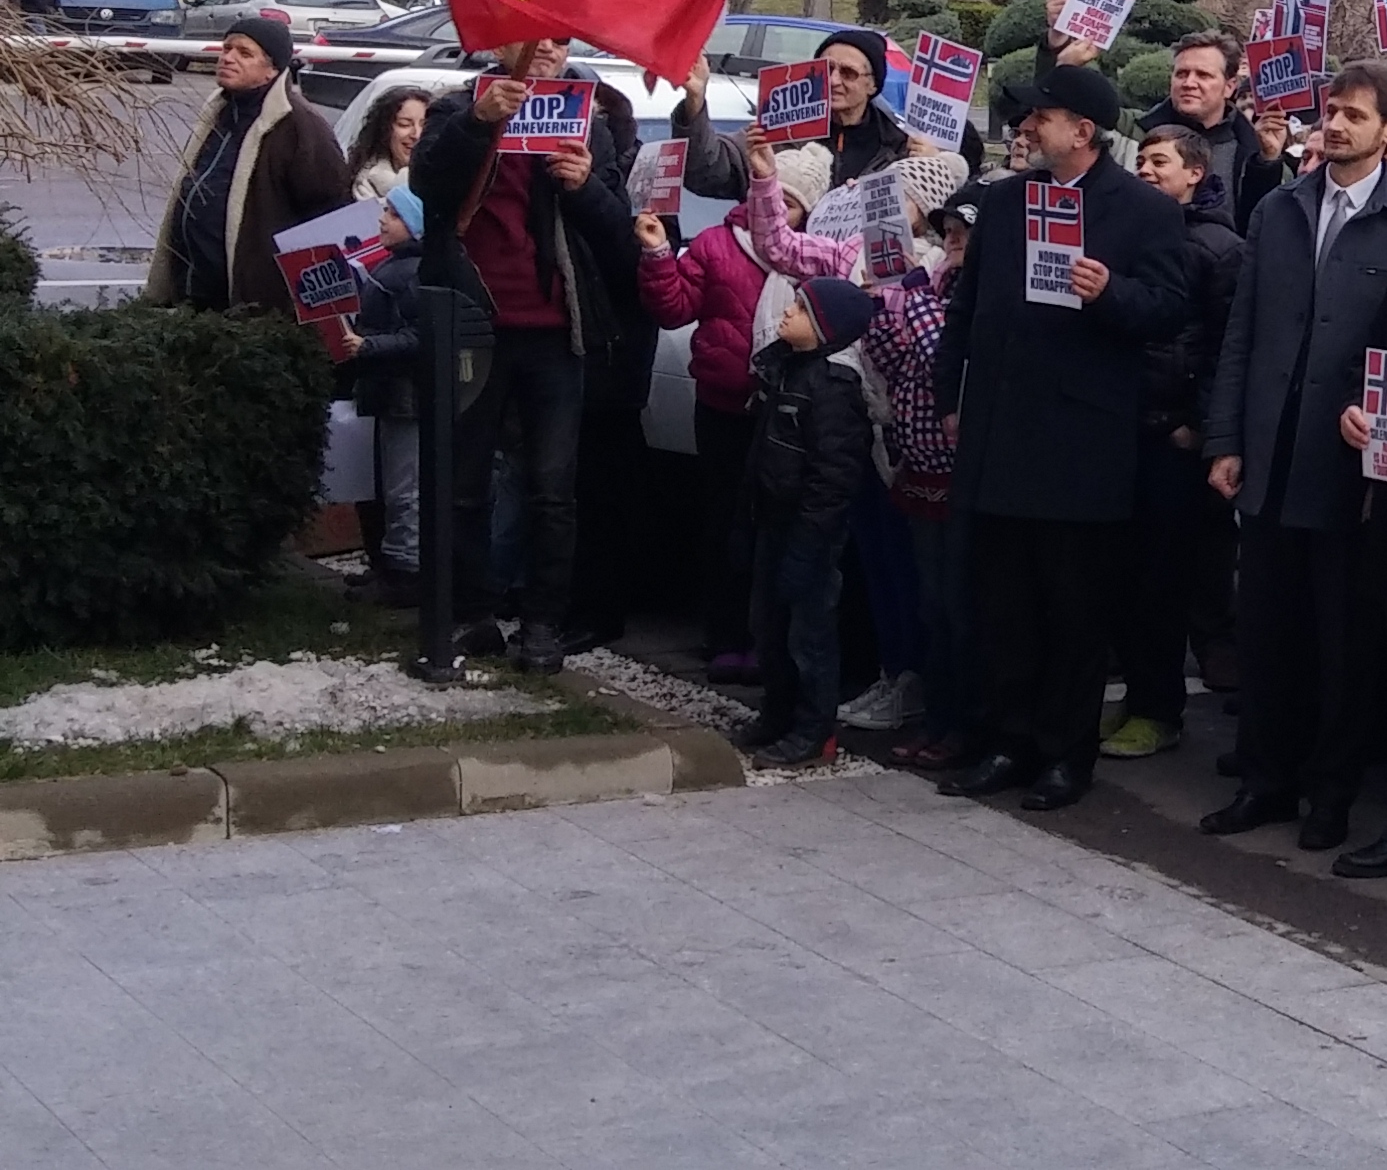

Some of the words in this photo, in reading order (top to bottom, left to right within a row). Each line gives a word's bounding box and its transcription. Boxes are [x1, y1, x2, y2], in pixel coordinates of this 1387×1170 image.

[1261, 55, 1292, 85] STOP
[511, 97, 562, 121] TOP
[771, 82, 812, 113] STOP
[506, 121, 583, 134] ARNEVERNET
[769, 104, 825, 126] BARNEVERNET
[910, 103, 928, 119] STOP
[929, 112, 957, 130] CHILD
[907, 117, 959, 143] KIDNAPPING!
[302, 262, 340, 291] STOP
[1033, 263, 1052, 277] STOP
[1054, 267, 1071, 280] CHI
